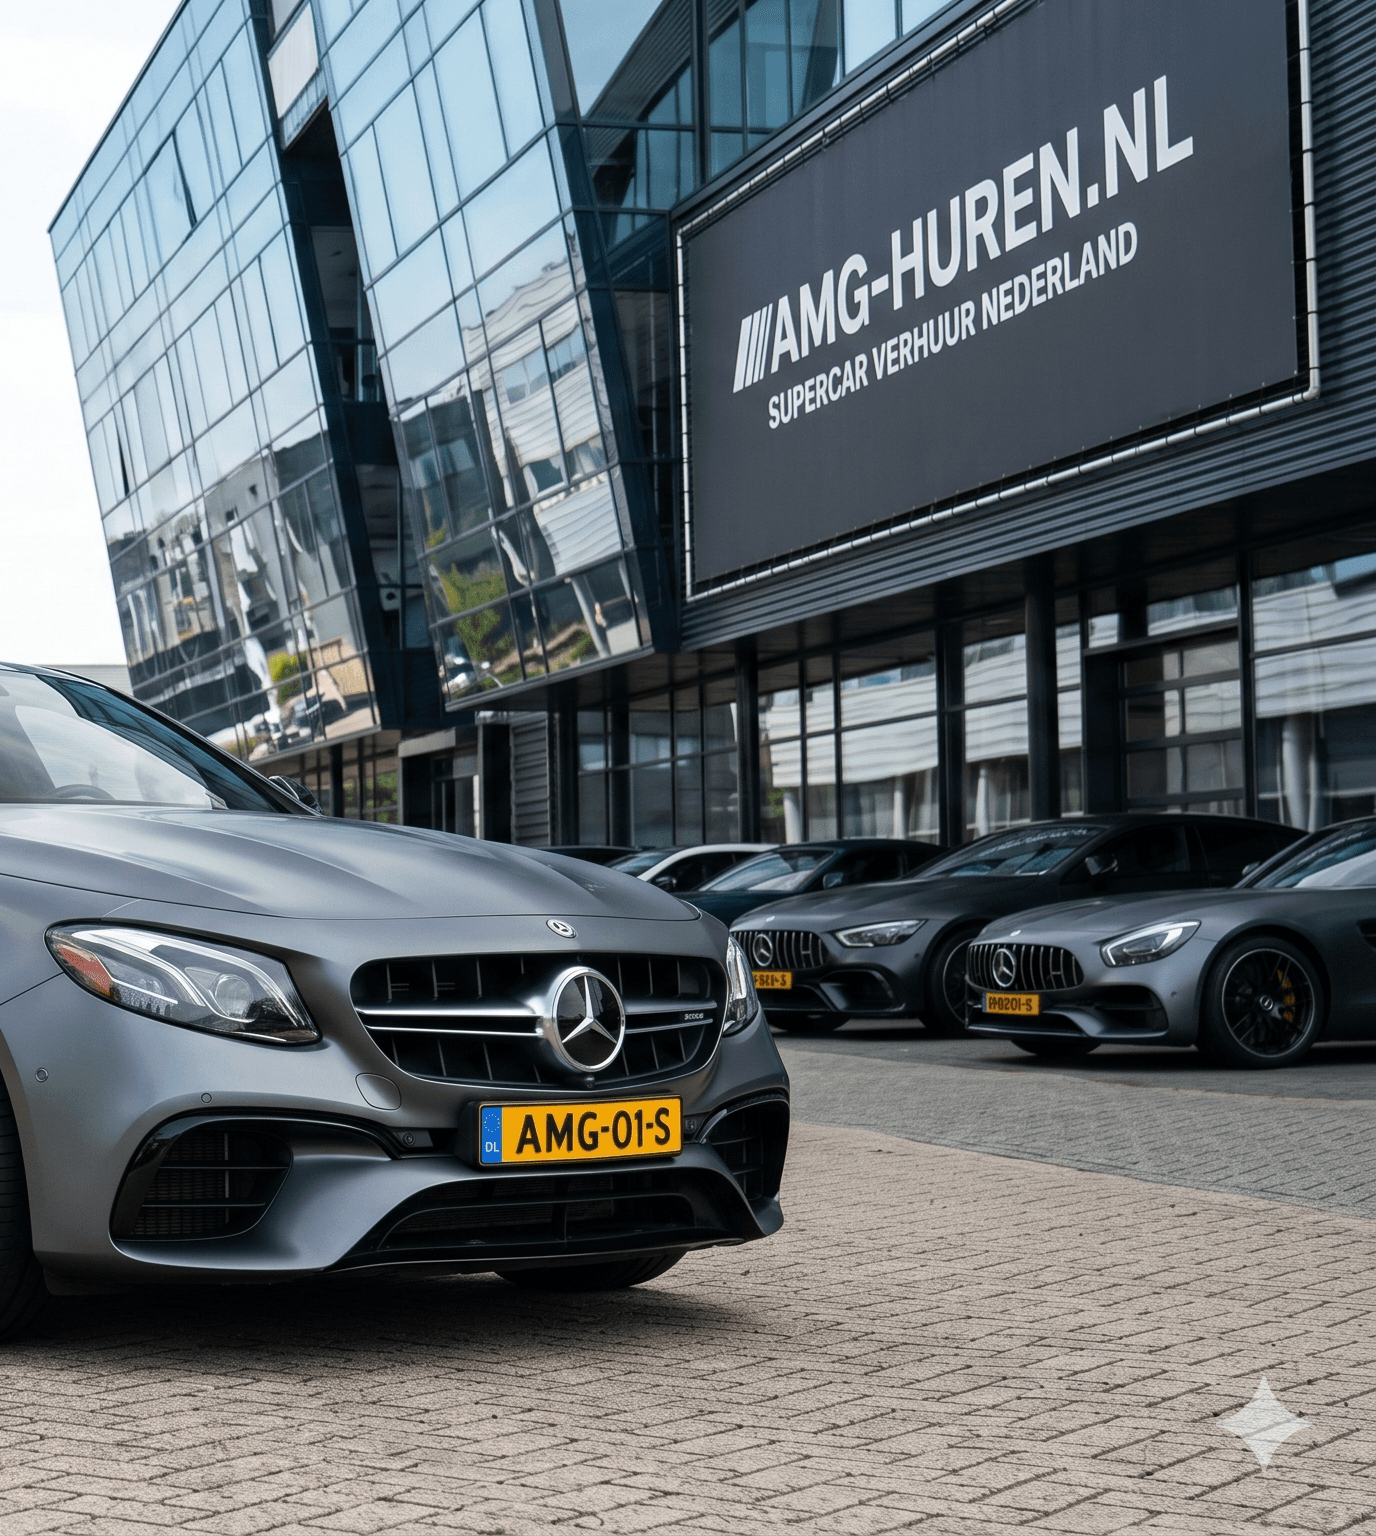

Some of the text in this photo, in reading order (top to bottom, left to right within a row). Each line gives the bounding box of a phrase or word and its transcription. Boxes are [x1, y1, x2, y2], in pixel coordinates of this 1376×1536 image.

[770, 74, 1194, 374] AMG-HUREN.NL
[768, 221, 1138, 430] SUPERCAR VERHUUR NEDERLAND
[485, 1142, 499, 1153] DL
[516, 1107, 671, 1155] AMG-01-S
